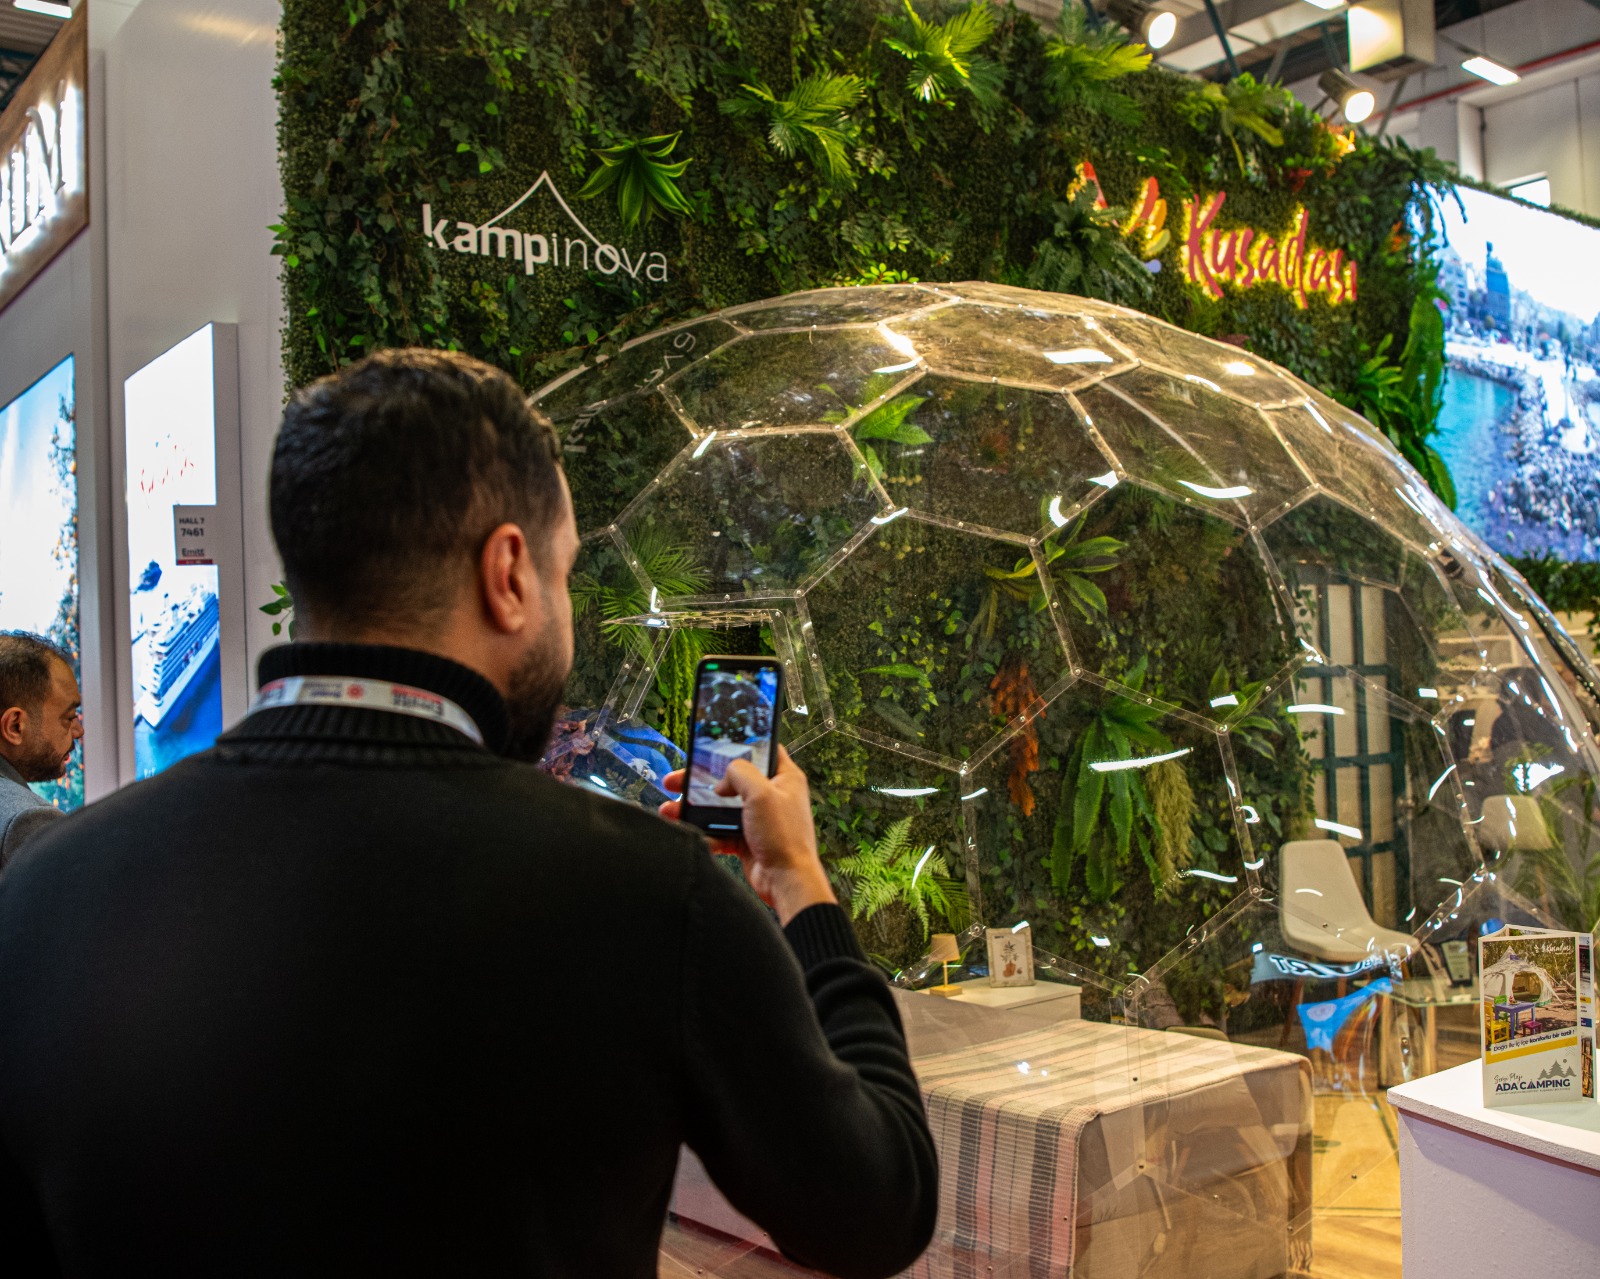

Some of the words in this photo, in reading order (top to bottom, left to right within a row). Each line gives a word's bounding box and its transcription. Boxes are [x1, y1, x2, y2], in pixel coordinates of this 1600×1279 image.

[422, 203, 668, 283] kampinova
[181, 527, 204, 537] 7461
[1496, 1083, 1518, 1092] ADA
[1520, 1079, 1571, 1090] CAMPING
